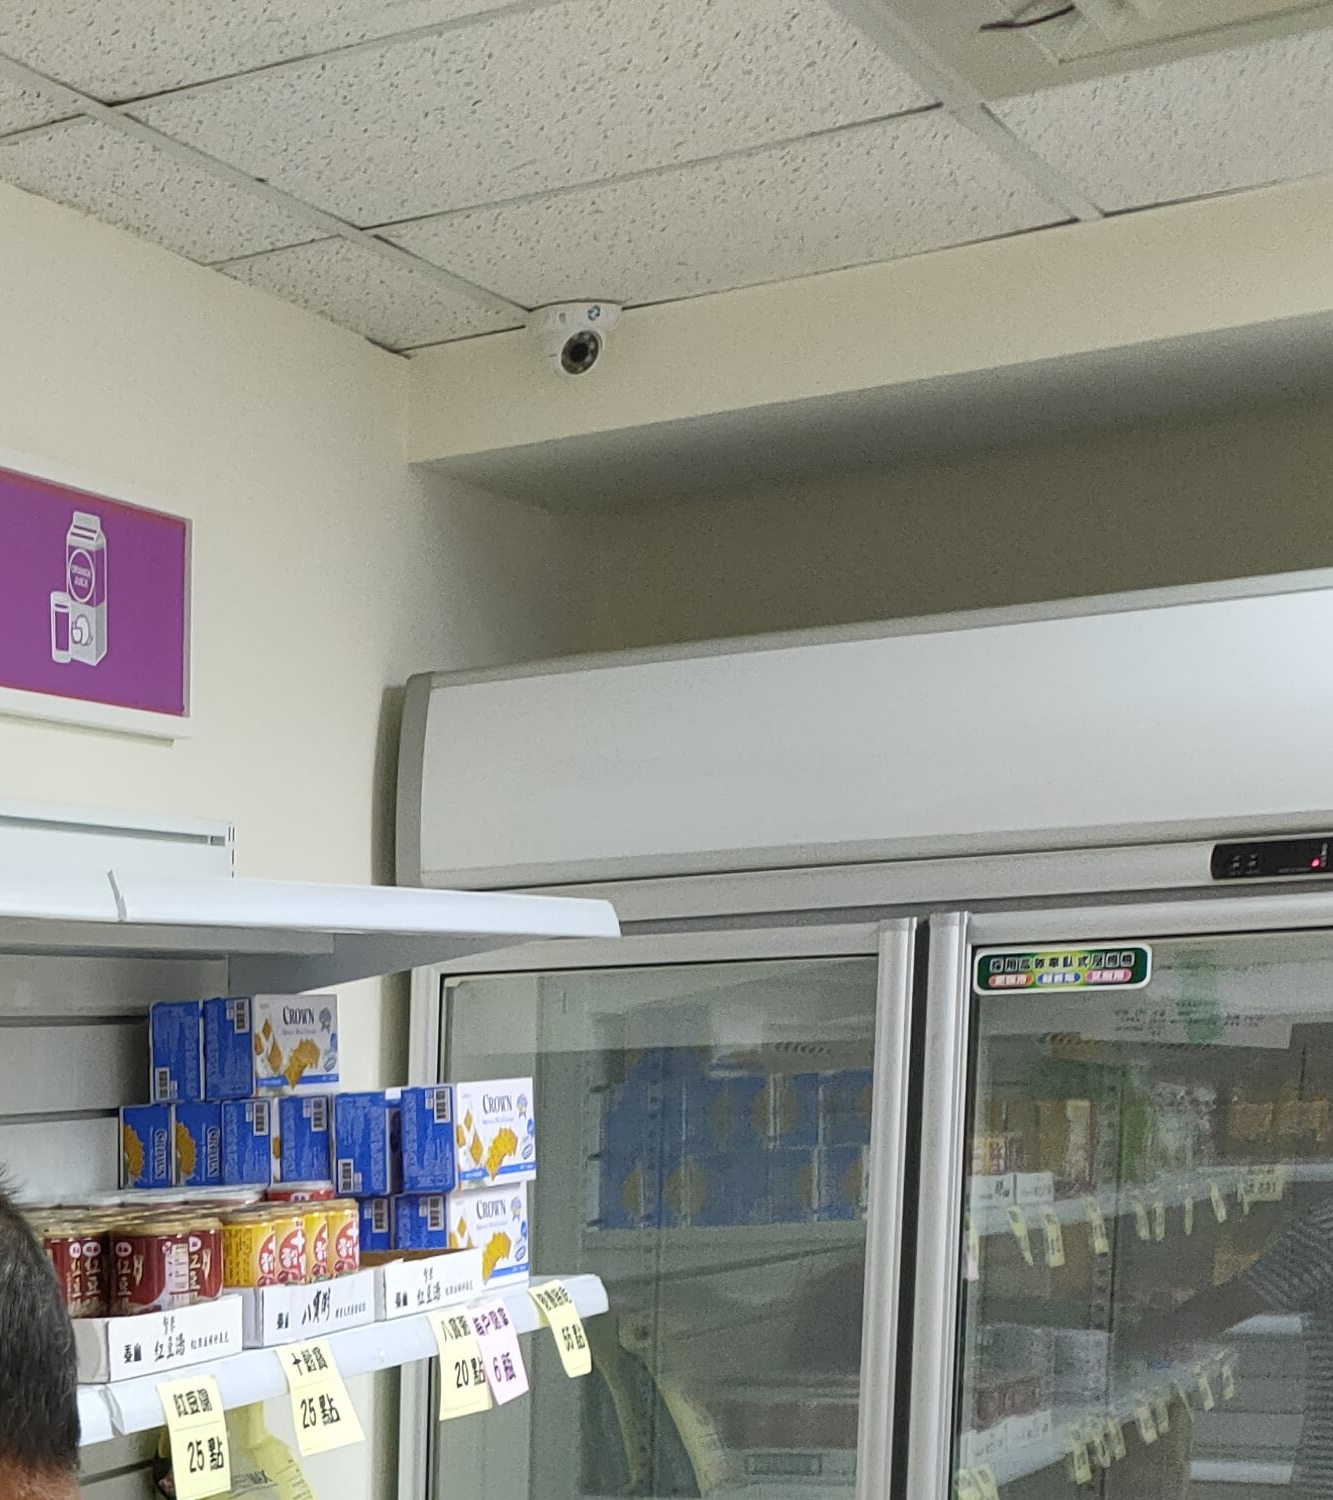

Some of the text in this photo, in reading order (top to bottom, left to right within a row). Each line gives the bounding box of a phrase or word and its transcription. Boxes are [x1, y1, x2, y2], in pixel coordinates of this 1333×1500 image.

[283, 1005, 315, 1026] CROWN
[483, 1094, 513, 1114] CROWN
[476, 1199, 507, 1220] CROWN
[454, 1359, 470, 1389] 20
[493, 1356, 502, 1383] 6
[300, 1393, 342, 1430] 25 點
[188, 1436, 225, 1474] 25 點
